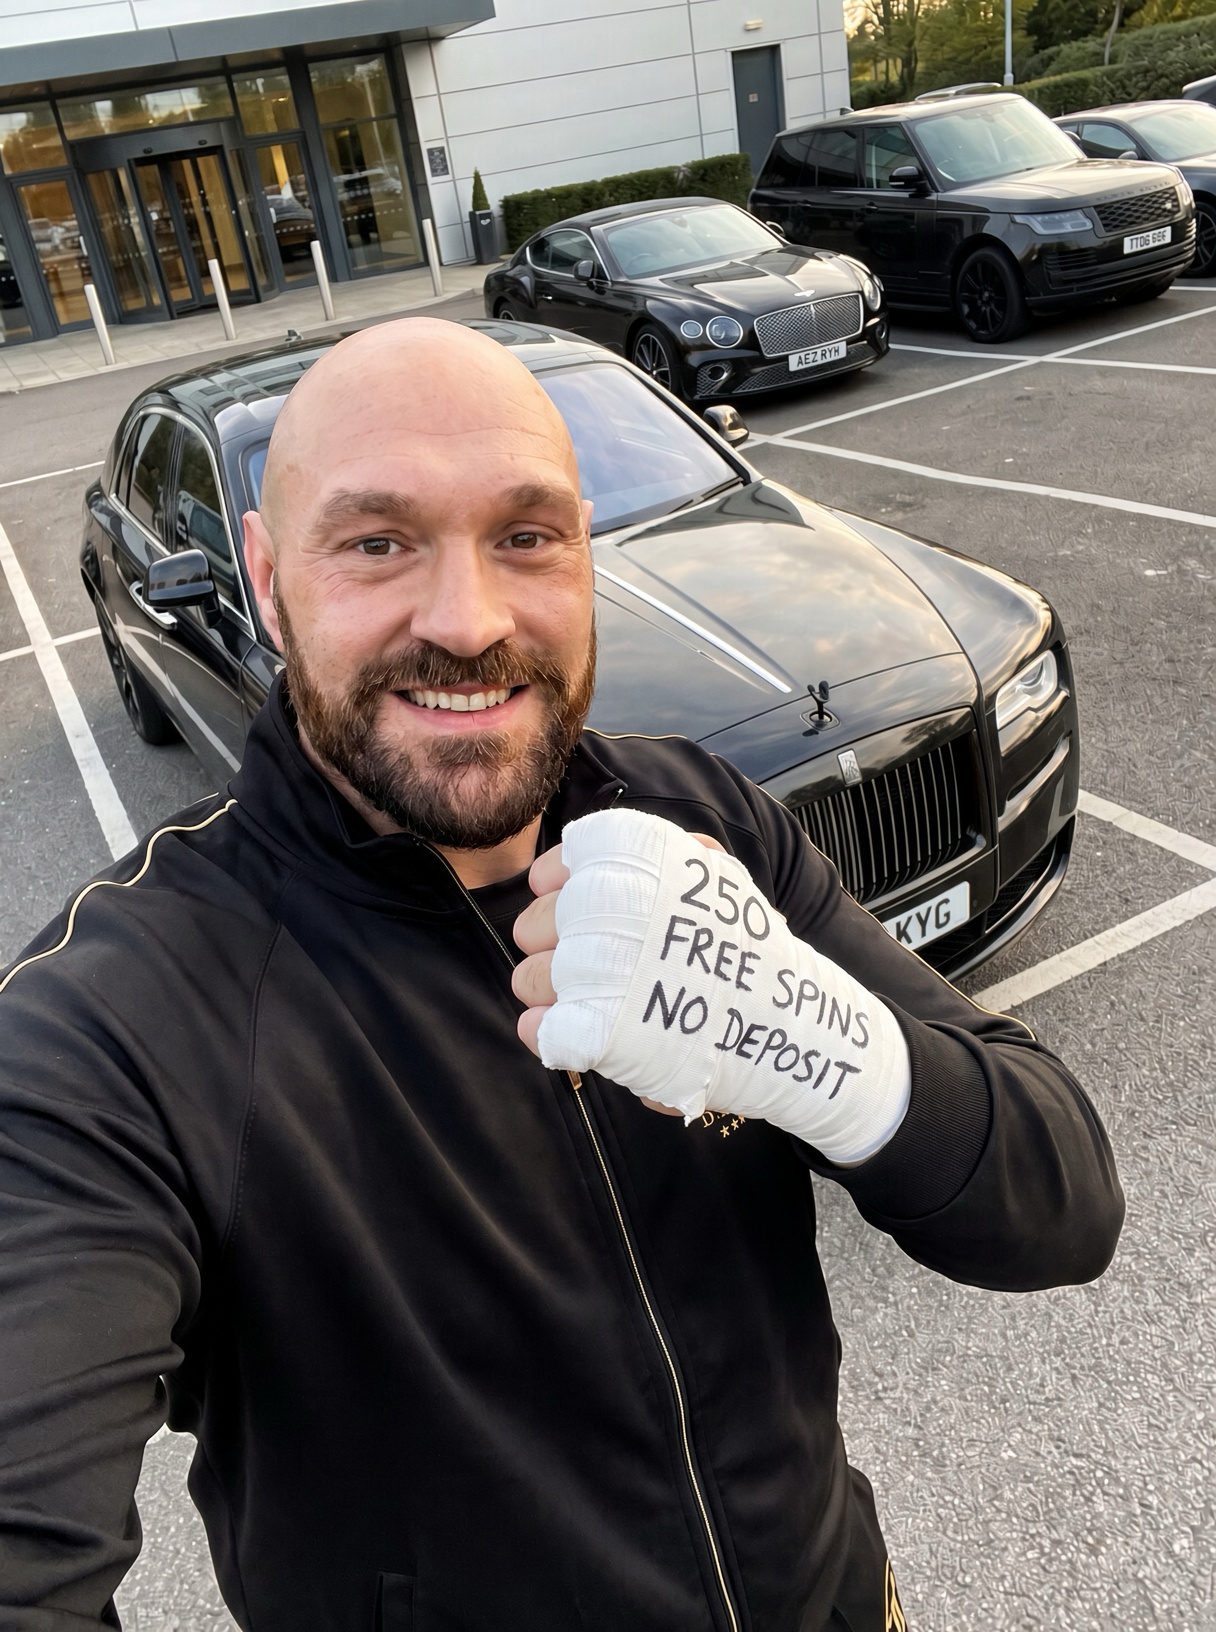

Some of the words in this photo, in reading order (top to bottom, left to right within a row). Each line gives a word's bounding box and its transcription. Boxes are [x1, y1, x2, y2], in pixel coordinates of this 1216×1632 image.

[797, 351, 818, 368] AEZ
[820, 346, 840, 361] RYH
[680, 858, 770, 941] 250
[895, 897, 951, 945] KYG
[660, 915, 761, 992] FREE
[772, 968, 869, 1049] SPINS
[642, 980, 709, 1035] NO
[714, 1007, 862, 1100] DEPOSIT
